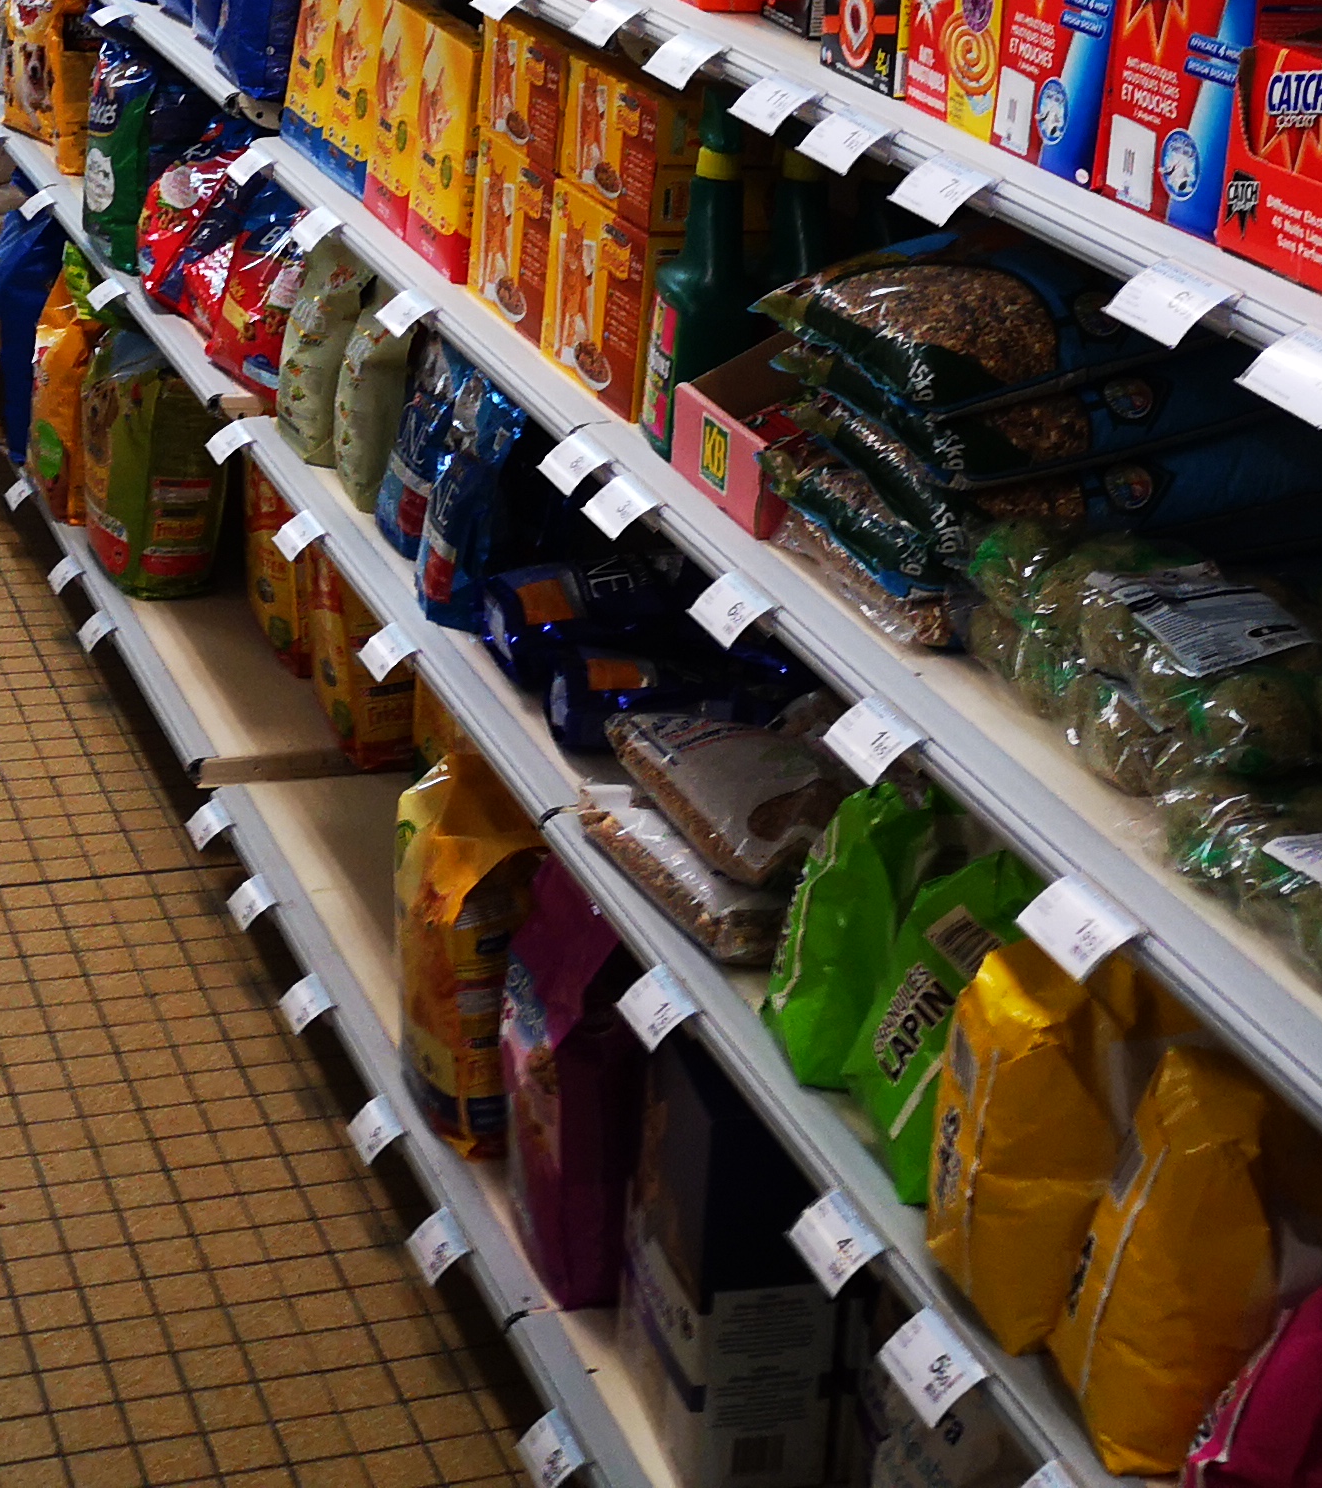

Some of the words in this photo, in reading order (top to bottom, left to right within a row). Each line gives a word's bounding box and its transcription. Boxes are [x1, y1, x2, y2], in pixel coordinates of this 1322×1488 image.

[1227, 181, 1259, 204] CATCH
[700, 425, 724, 480] KB
[879, 978, 956, 1085] LAPIN
